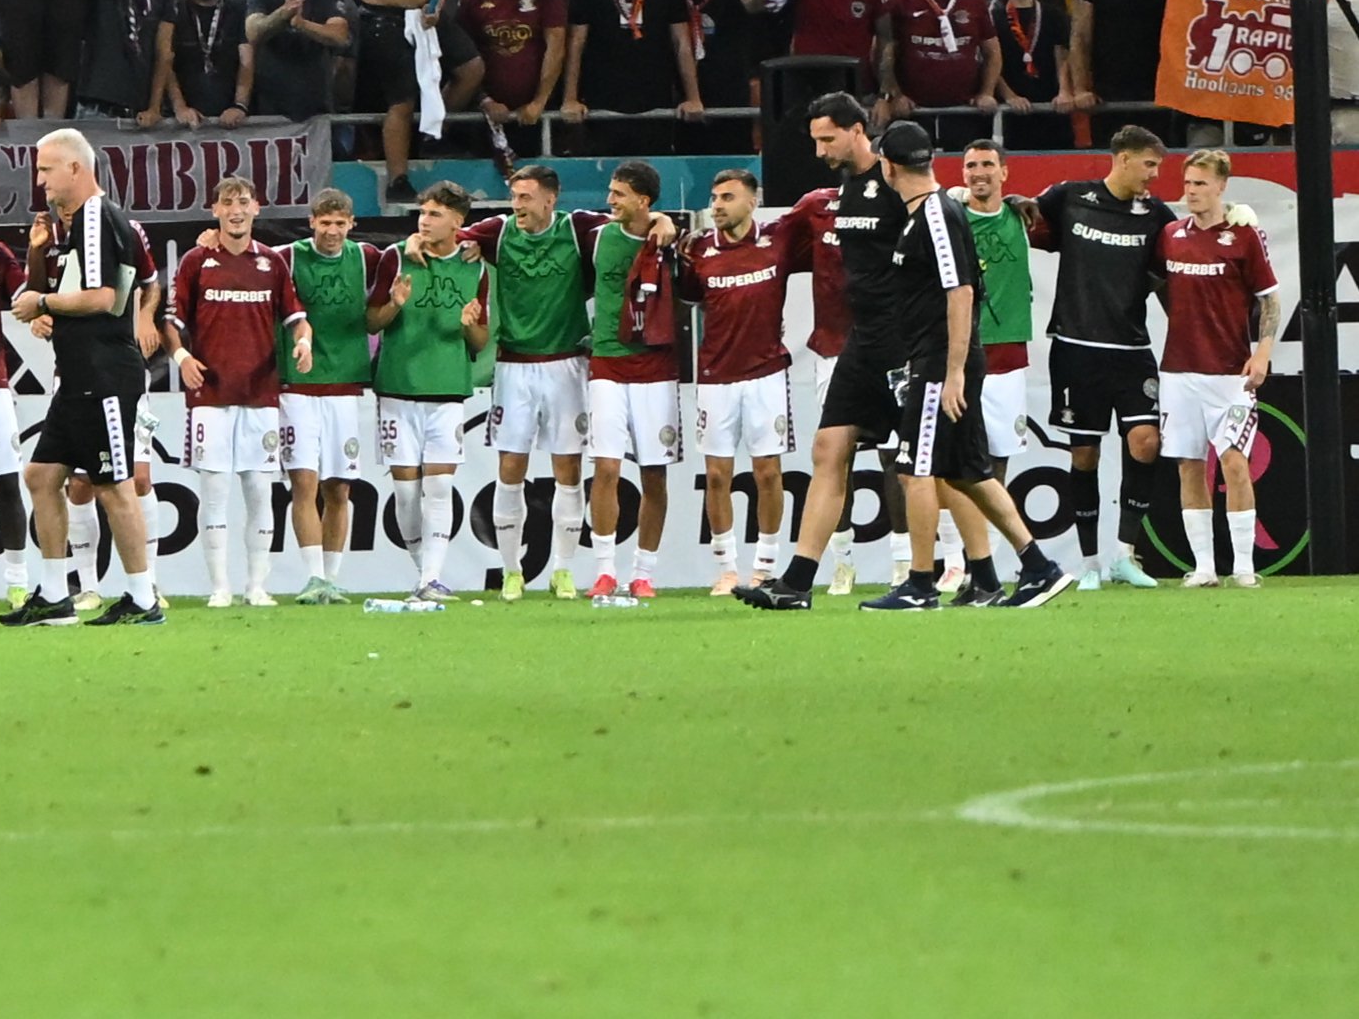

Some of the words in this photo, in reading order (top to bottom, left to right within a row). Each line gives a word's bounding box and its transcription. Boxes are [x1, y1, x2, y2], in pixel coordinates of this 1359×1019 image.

[1071, 222, 1148, 247] SUPERBET
[706, 265, 778, 290] SUPERBET
[1166, 258, 1226, 277] SUPERBET
[204, 287, 273, 304] SUPERBET
